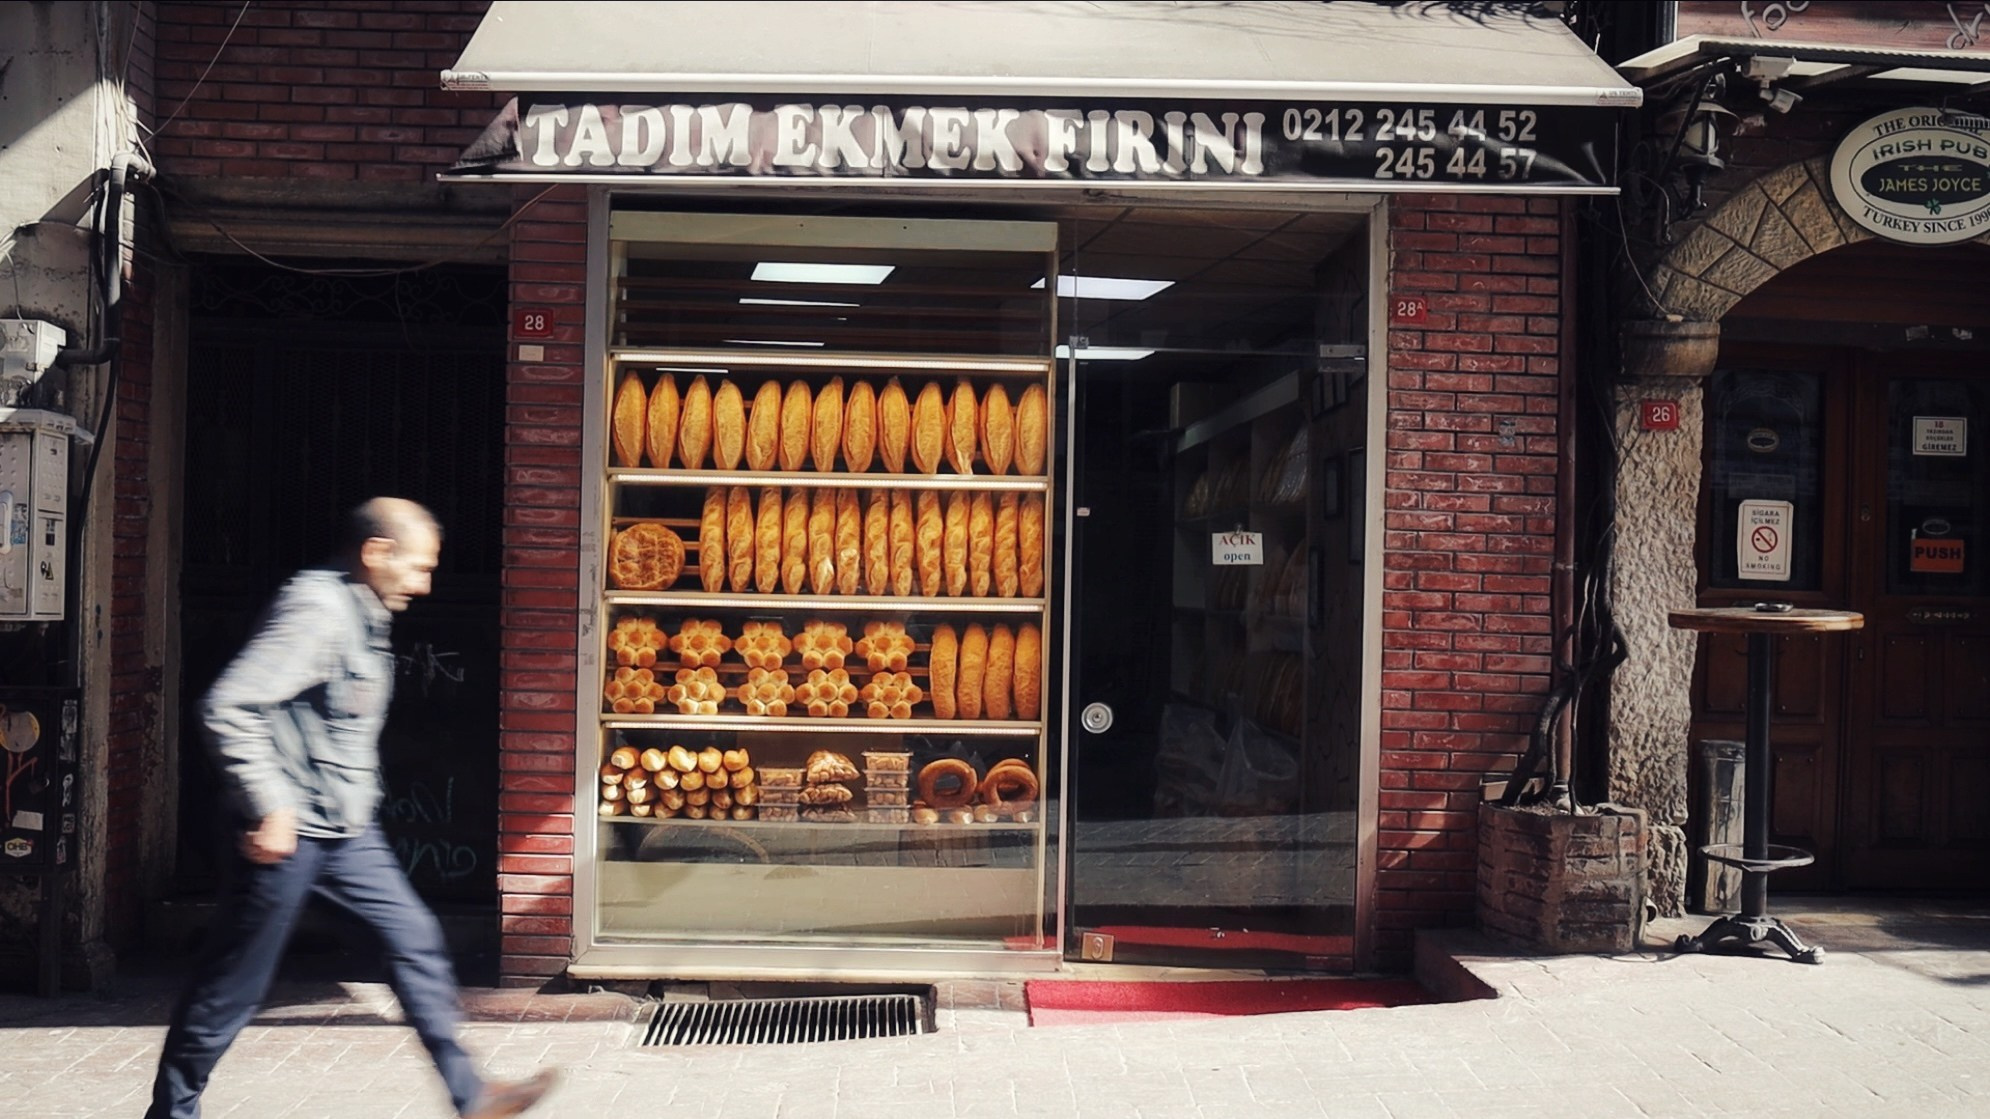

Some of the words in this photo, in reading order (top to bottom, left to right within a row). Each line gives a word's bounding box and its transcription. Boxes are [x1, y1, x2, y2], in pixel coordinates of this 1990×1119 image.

[1282, 108, 1364, 141] 0212
[1375, 109, 1436, 141] 245
[1447, 109, 1486, 142] 44
[1499, 110, 1537, 142] 52
[1873, 117, 1907, 137] THE
[526, 103, 753, 167] TADIM
[772, 103, 1023, 172] EKMEK
[1044, 108, 1265, 175] FIRINI
[1872, 138, 1932, 160] IRISH
[1940, 138, 1988, 159] PUB
[1375, 148, 1436, 179] 245
[1446, 148, 1487, 179] 44
[1499, 149, 1538, 179] 57
[1898, 164, 1963, 172] THE
[1879, 178, 1928, 192] JAMES
[1932, 178, 1982, 192] JOYCE
[1862, 205, 1921, 233] TURKEY
[1923, 218, 1967, 233] SINCE
[524, 314, 545, 331] 28
[1652, 406, 1671, 422] 26
[1752, 509, 1780, 517] SİGARA
[1219, 534, 1256, 548] AÇIK
[1223, 553, 1251, 563] open
[1914, 546, 1961, 560] PUSH
[1746, 562, 1781, 570] SMOKING
